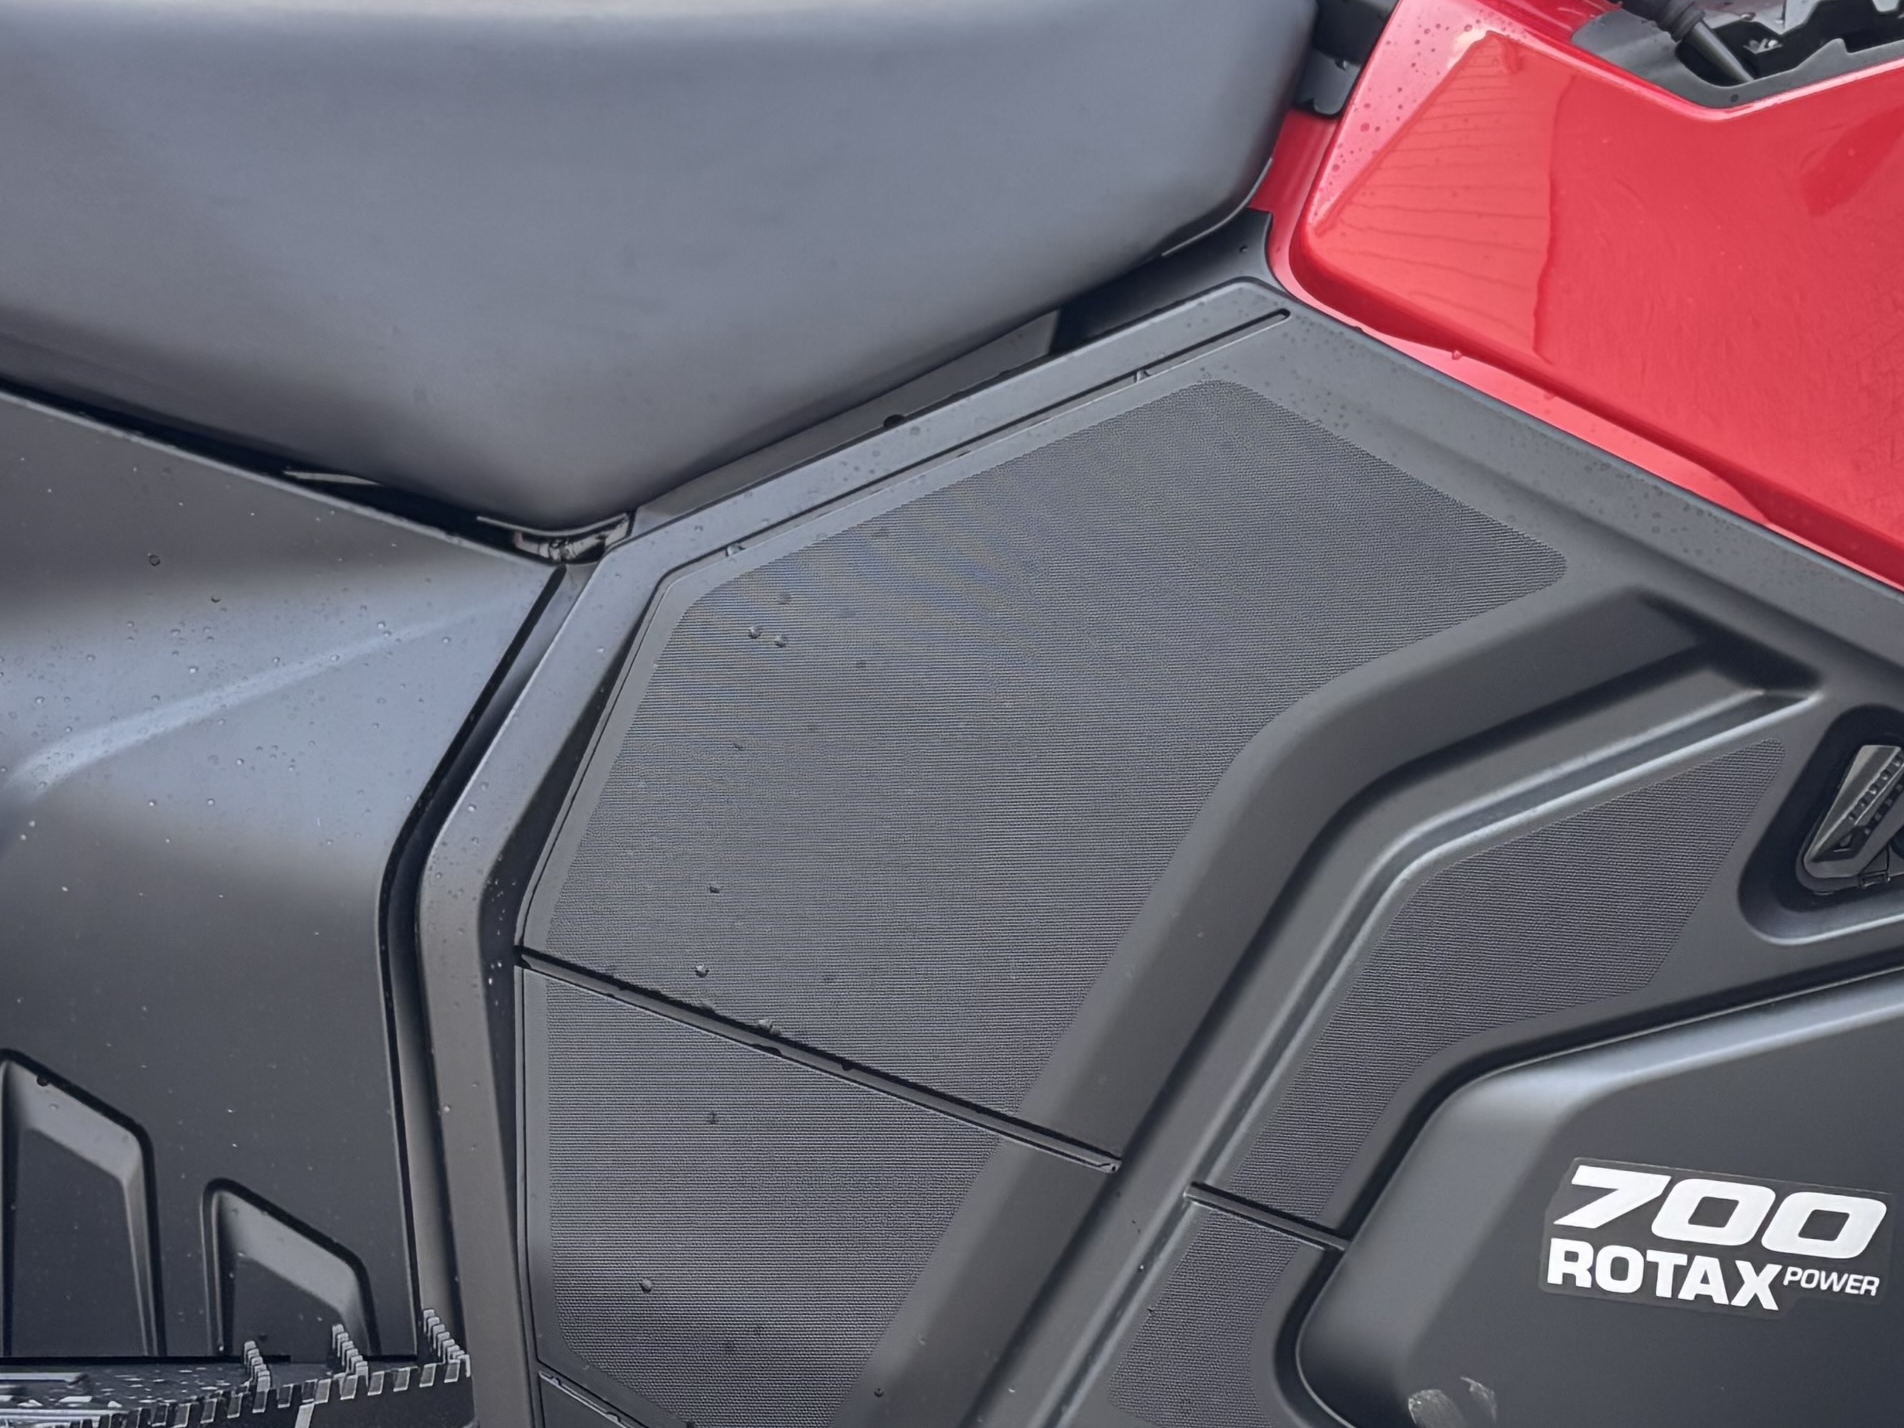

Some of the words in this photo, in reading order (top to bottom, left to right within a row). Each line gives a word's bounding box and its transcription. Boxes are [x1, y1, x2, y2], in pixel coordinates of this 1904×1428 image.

[1553, 1165, 1887, 1259] 700
[1546, 1237, 1782, 1310] ROTAX
[1783, 1267, 1881, 1297] POWER
